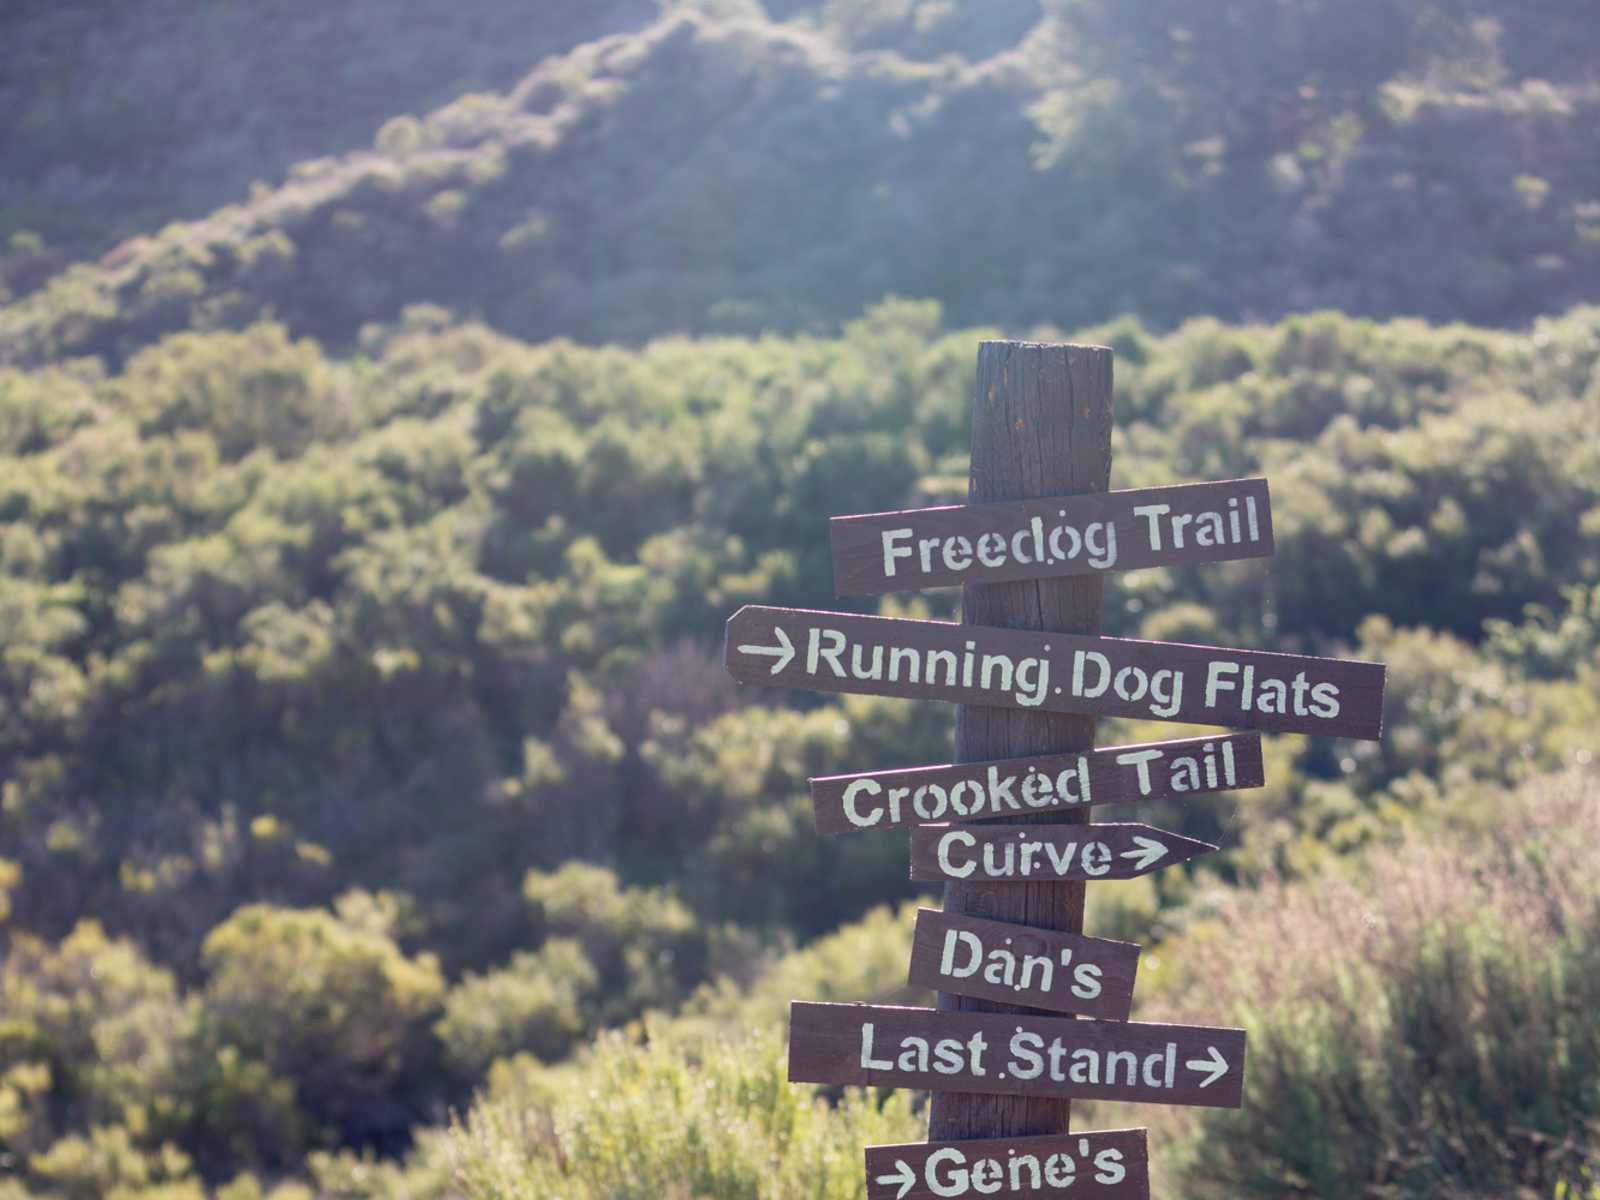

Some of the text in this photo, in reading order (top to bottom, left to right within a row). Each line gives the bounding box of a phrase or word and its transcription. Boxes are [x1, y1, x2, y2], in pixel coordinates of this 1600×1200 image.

[1133, 495, 1262, 551] Trail
[806, 627, 1342, 720] Running Dog Flats
[841, 740, 1237, 828] Crooked Tail
[937, 830, 1113, 879] Curve
[939, 928, 1104, 1000] Dan's
[860, 1022, 1178, 1089] Last Stand
[924, 1138, 1127, 1197] Gene's
